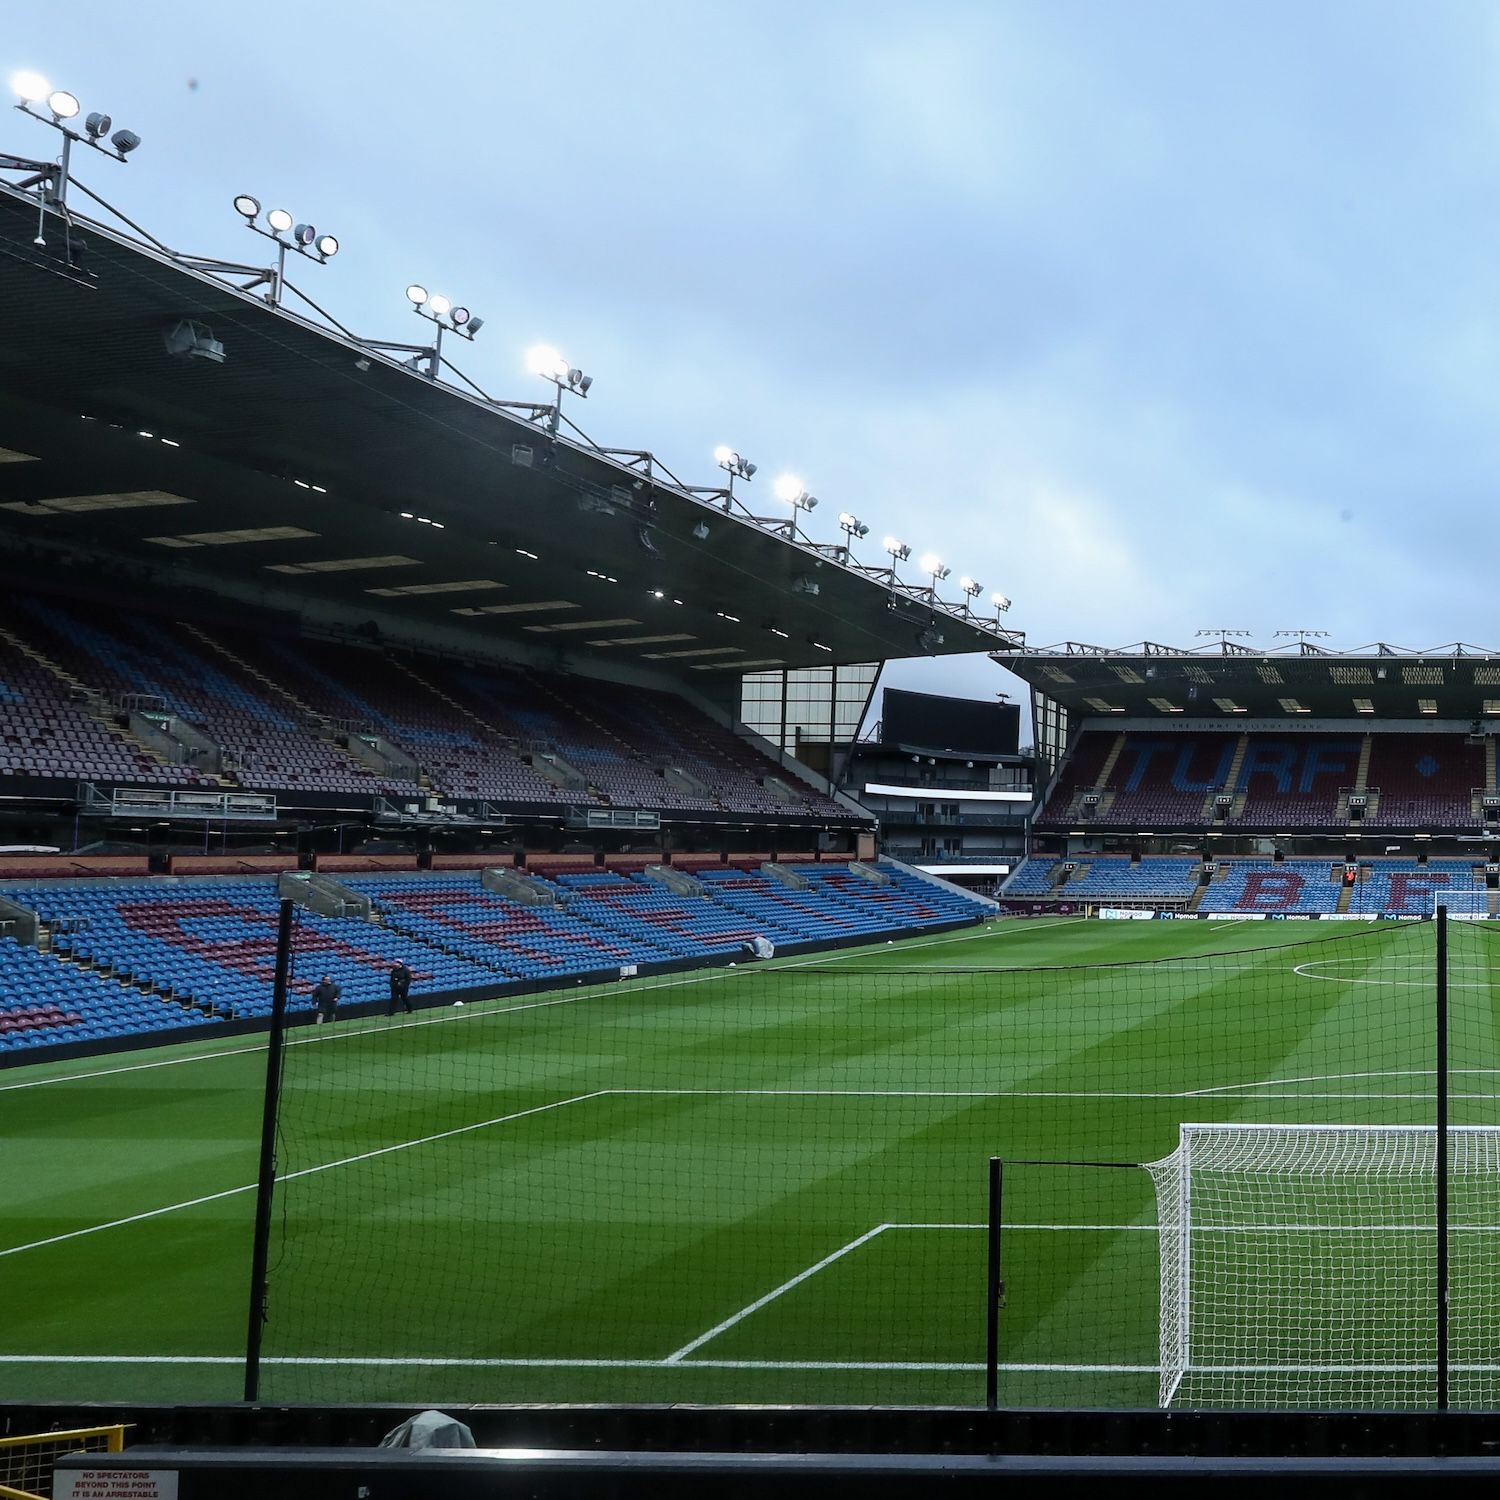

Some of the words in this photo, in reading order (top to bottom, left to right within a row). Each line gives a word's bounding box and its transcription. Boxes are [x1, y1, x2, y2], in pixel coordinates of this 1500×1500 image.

[1122, 740, 1364, 793] TURF
[97, 1472, 150, 1480] SPECTATORS
[75, 1481, 109, 1489] BEYOND
[111, 1481, 130, 1489] THIS
[131, 1481, 157, 1489] POINT
